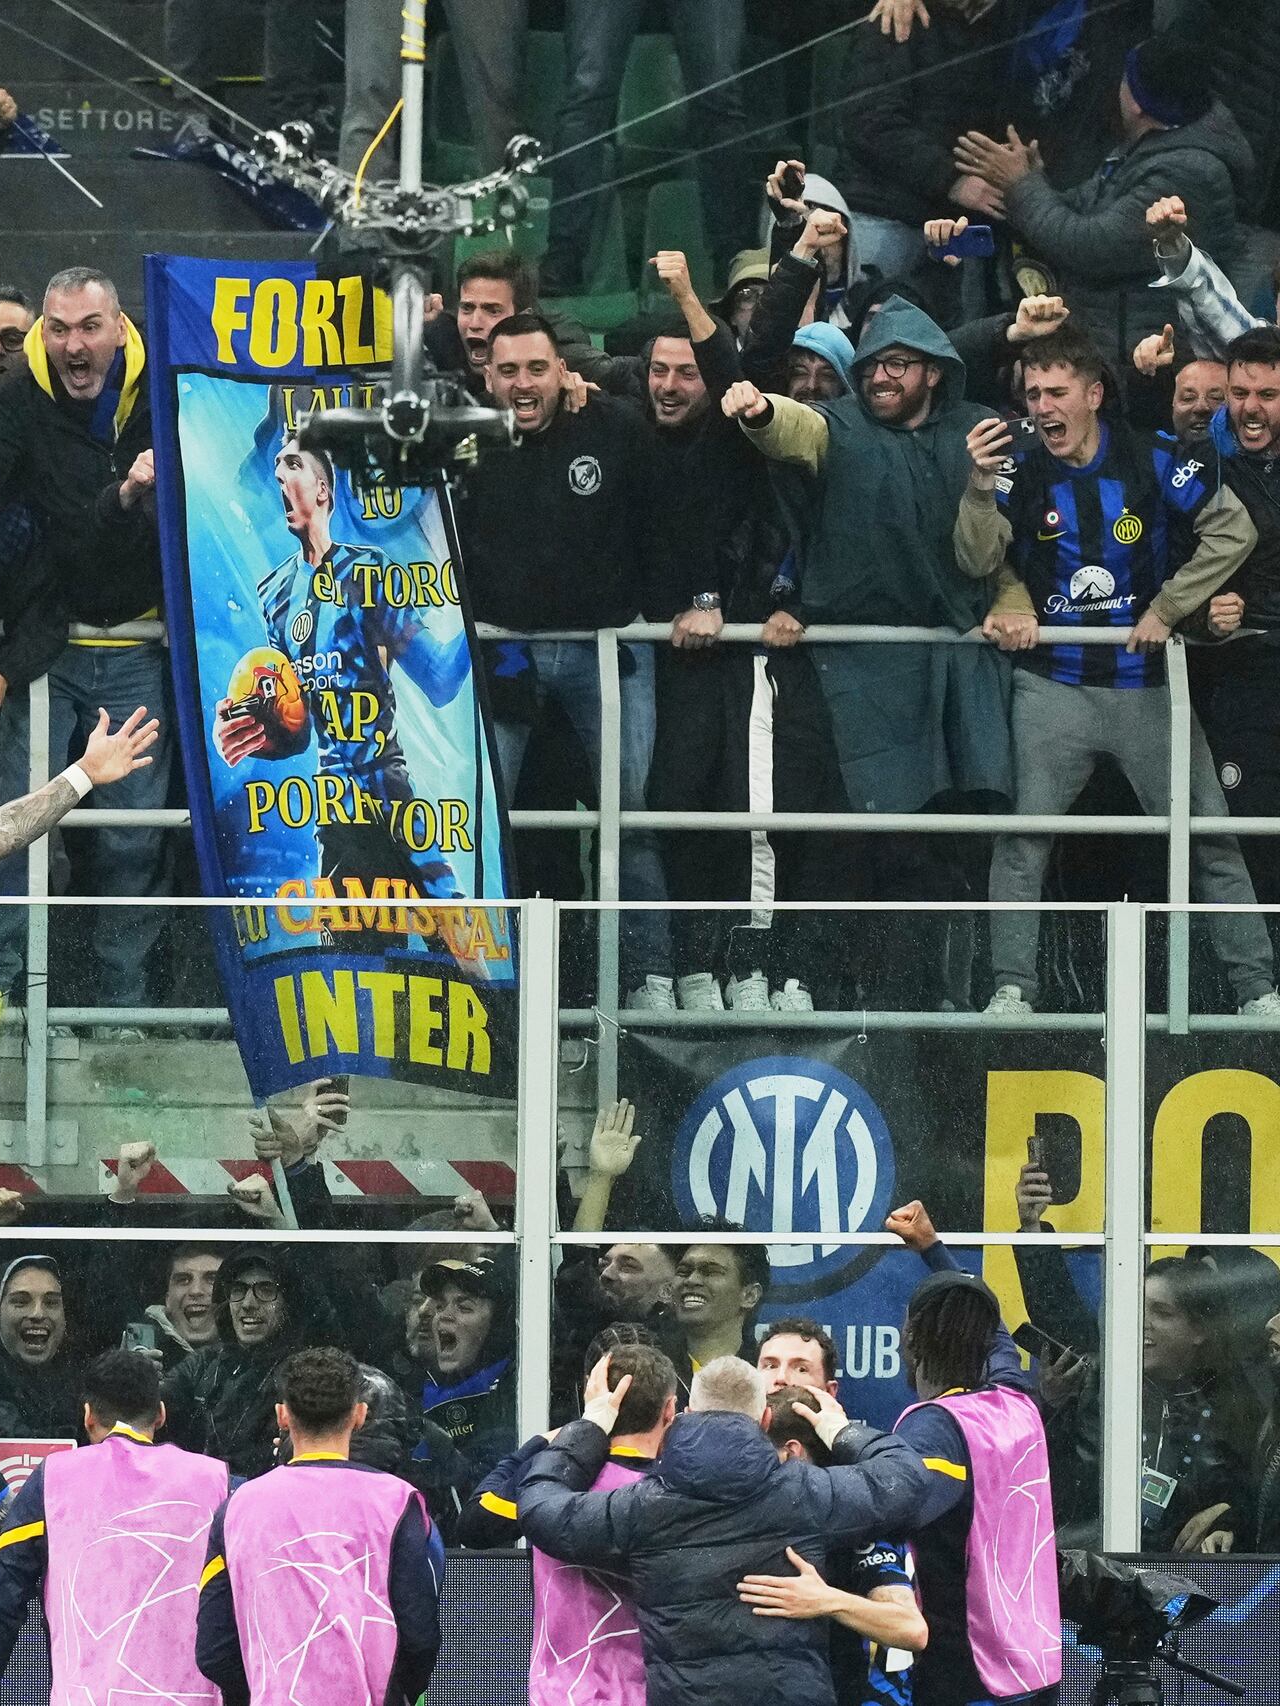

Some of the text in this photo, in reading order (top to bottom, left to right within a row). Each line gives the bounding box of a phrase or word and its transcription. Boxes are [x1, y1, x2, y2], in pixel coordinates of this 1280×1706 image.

[37, 109, 173, 131] SETTORE
[1043, 594, 1137, 615] Paramount+
[273, 969, 491, 1075] INTER
